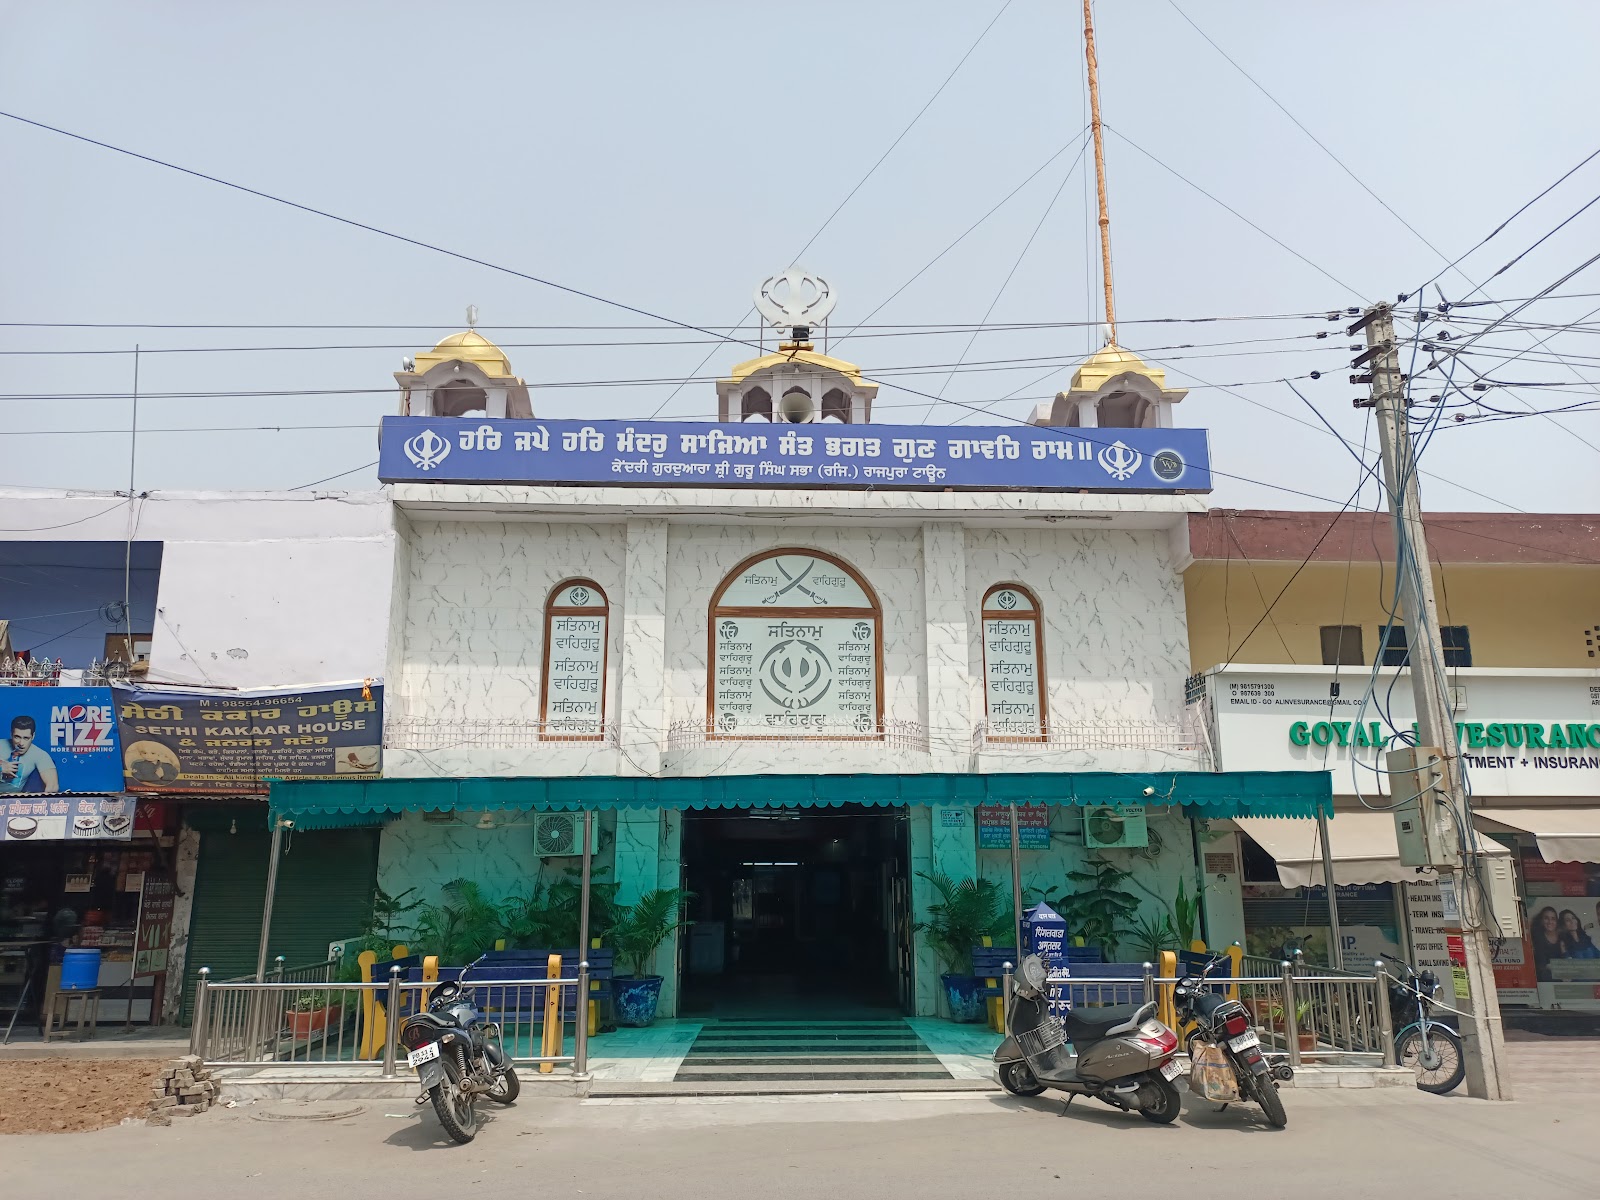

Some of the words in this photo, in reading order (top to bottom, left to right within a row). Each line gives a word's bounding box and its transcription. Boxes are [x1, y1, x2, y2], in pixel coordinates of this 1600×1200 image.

[459, 425, 502, 451] ਹਰਿ
[562, 426, 604, 452] ਹਰਿ
[616, 427, 669, 458] ਮੰਦਰੁ
[680, 429, 768, 455] ਸਾਜਿਆ
[779, 430, 814, 458] ਸੰਤ
[824, 436, 882, 458] ਭਗਤ
[892, 438, 937, 463] ਗੁਣ
[948, 434, 1020, 460] ਗਾਵਹਿ
[652, 462, 711, 477] ਗੁਰਦੁਆਰਾ
[734, 464, 755, 480] ਗੁਰੂ
[759, 461, 786, 476] ਸਿੰਘ
[790, 465, 813, 477] ਸਭਾ
[818, 462, 858, 479] (ਰਜਿ.)
[863, 466, 908, 480] ਰਾਜਪੁਰਾ
[912, 464, 947, 483] ਟਾਊਨ
[556, 617, 600, 633] ਸਤਿਨਾਮੁ
[767, 621, 823, 640] ਸਤਿਨਾਮੁ
[987, 621, 1030, 636] ਸਤਿਨਾਮੁ
[555, 635, 600, 652] ਵਾਹਿਗੁਰੂ
[988, 638, 1032, 655] ਵਾਹਿਗੁਰੂ
[554, 657, 599, 674] ਸਤਿਨਾਮੁ
[989, 660, 1032, 676] ਸਤਿਨਾਮੁ
[553, 675, 598, 692] ਵਾਹਿਗੁਰੂ
[990, 678, 1034, 695] ਵਾਹਿਗੁਰੂ
[121, 701, 184, 720] ਸੇਠੀ
[200, 708, 281, 720] ਕਕਾਰ
[297, 699, 377, 720] ਹਾਊਸ
[222, 697, 302, 707] 98554-96654
[552, 698, 597, 715] ਸਤਿਨਾਮੁ
[991, 700, 1035, 716] ਸਤਿਨਾਮੁ
[51, 705, 112, 722] MORE
[50, 722, 114, 746] FIZZ
[135, 726, 198, 736] SETHI
[204, 725, 291, 736] KAKAAR
[298, 720, 366, 734] HOUSE
[1289, 721, 1389, 748] GOYAL
[179, 738, 196, 747] &
[204, 738, 272, 747] ਜਨਰਲ
[1466, 756, 1515, 768] TMENT
[1534, 756, 1600, 769] INSURAN
[1341, 936, 1357, 950] IP.
